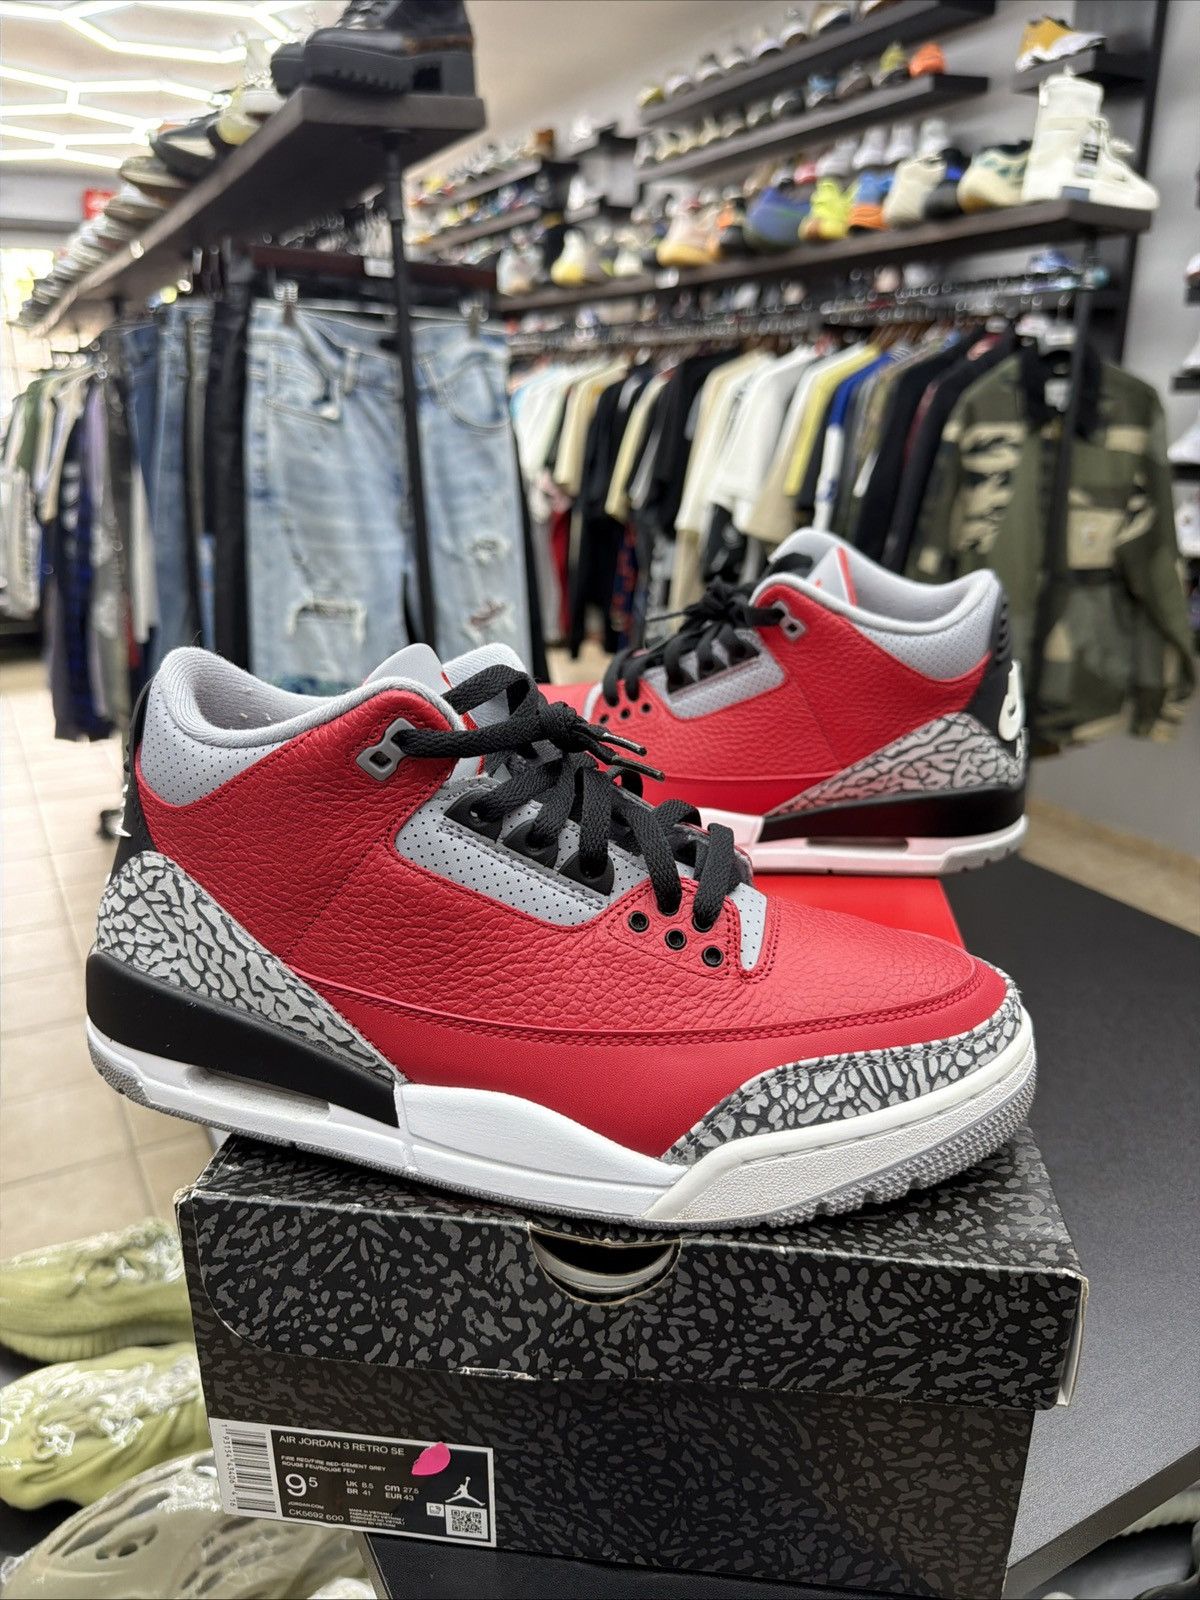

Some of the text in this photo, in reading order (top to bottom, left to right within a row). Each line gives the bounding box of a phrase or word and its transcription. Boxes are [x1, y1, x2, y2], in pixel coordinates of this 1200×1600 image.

[279, 1435, 405, 1456] AIR JORDAN 3 RETRO SE
[281, 1460, 304, 1468] ROUGE
[296, 1456, 324, 1465] RED/FIRE
[326, 1460, 368, 1470] RED-CEMENT
[345, 1480, 374, 1490] UK 8.5
[384, 1484, 420, 1495] cm 27.5
[346, 1487, 359, 1495] BR
[385, 1492, 415, 1502] EUR 43
[325, 1514, 345, 1522] 600
